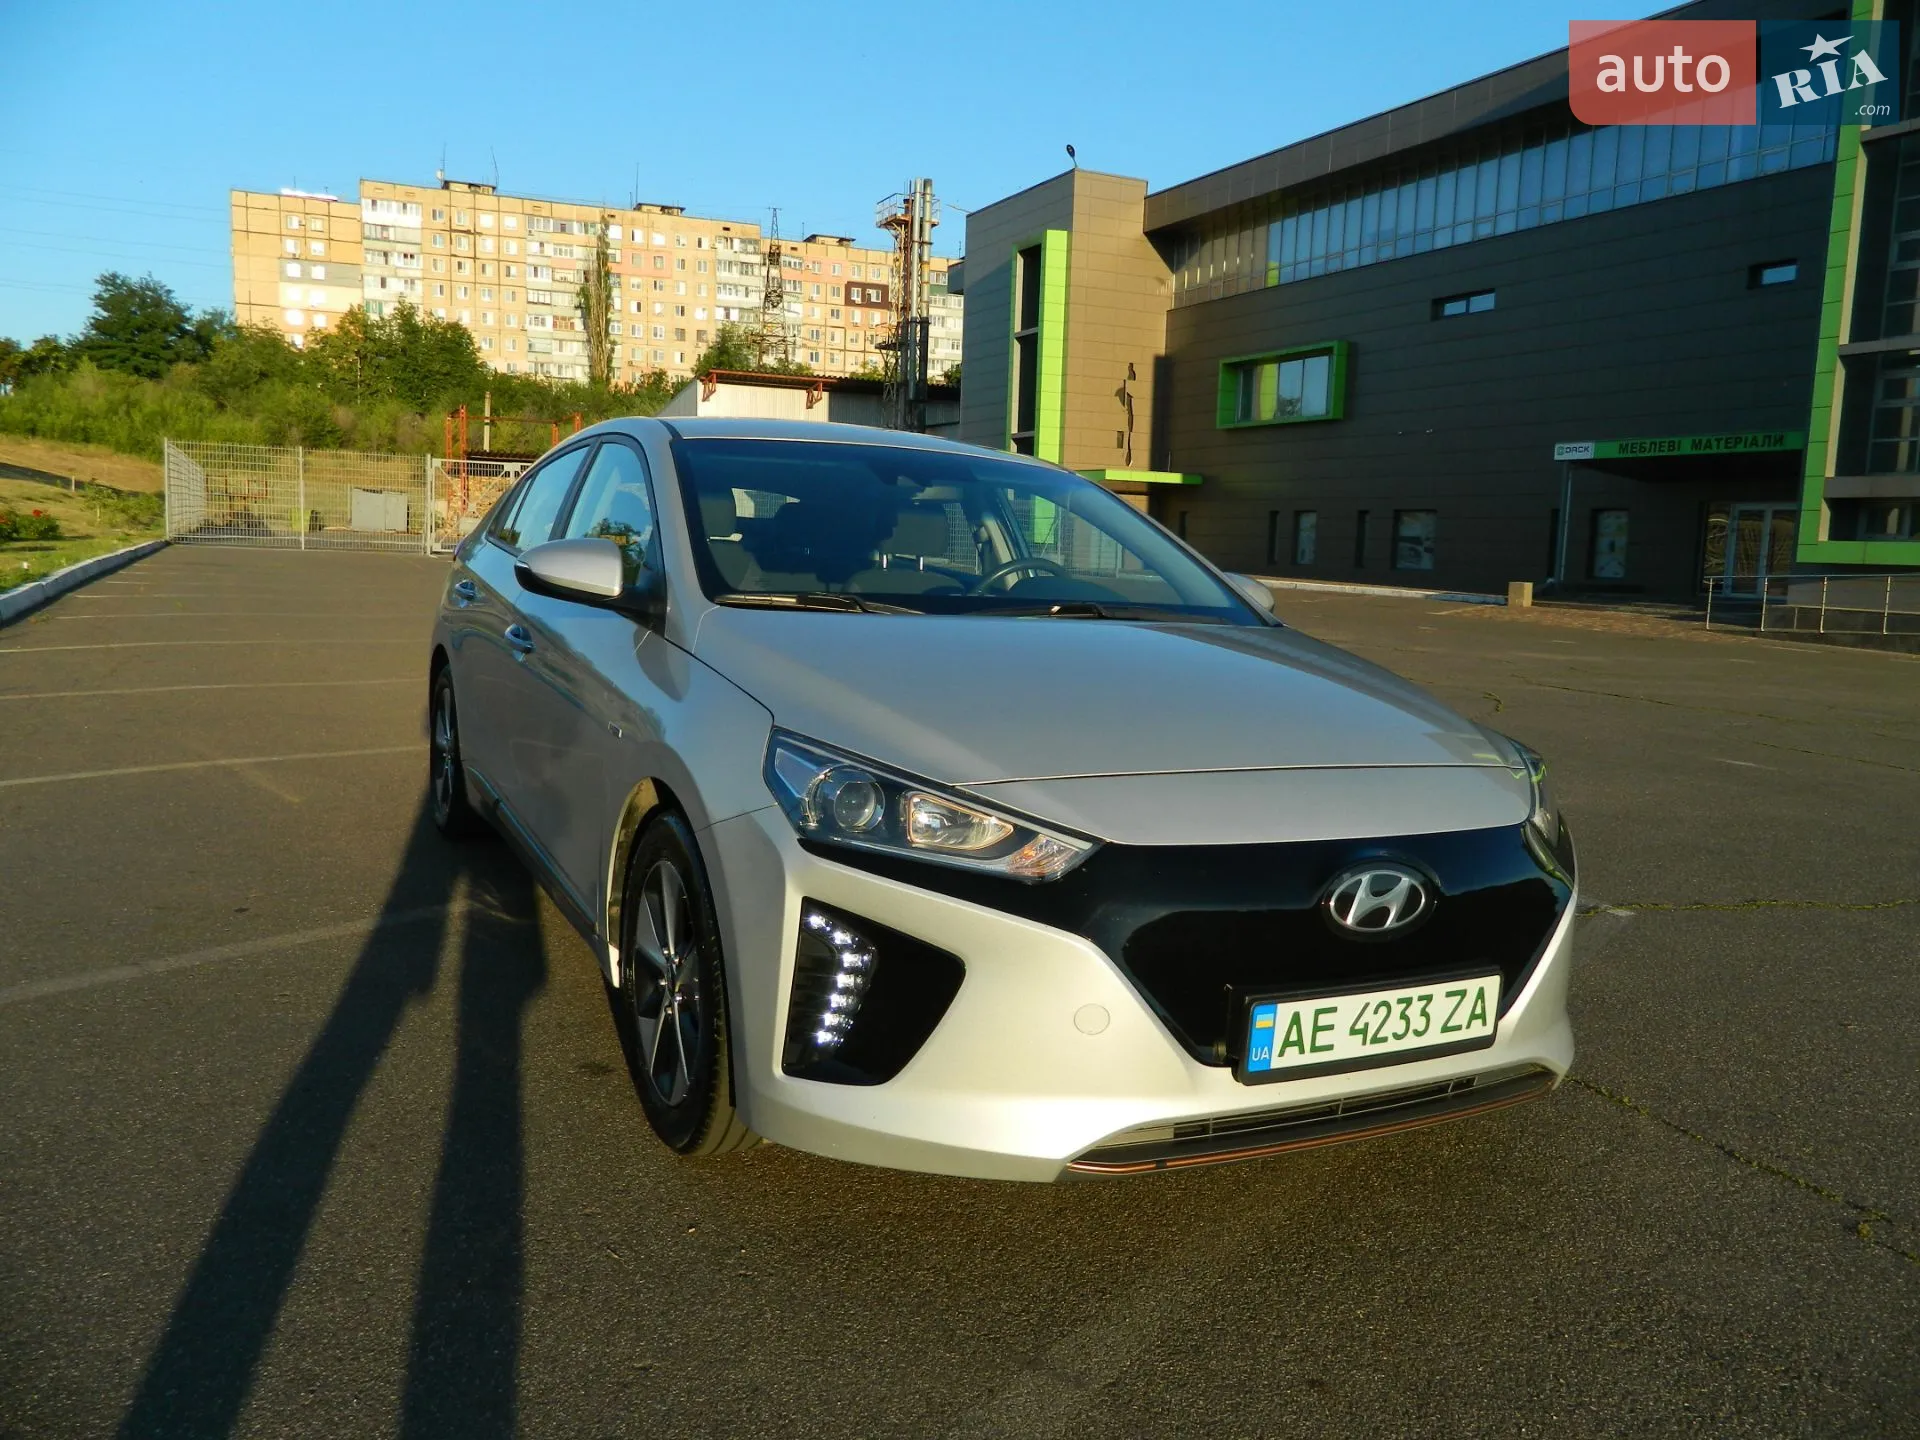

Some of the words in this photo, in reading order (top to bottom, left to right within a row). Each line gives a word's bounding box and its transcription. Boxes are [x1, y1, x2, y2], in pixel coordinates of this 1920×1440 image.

[1617, 438, 1682, 455] МЕБЛЕВІ
[1690, 434, 1785, 452] МАТЕРІАЛИ
[1277, 1006, 1338, 1057] AE
[1349, 993, 1434, 1046] 4233
[1440, 986, 1488, 1034] ZA
[1251, 1046, 1270, 1062] UA
